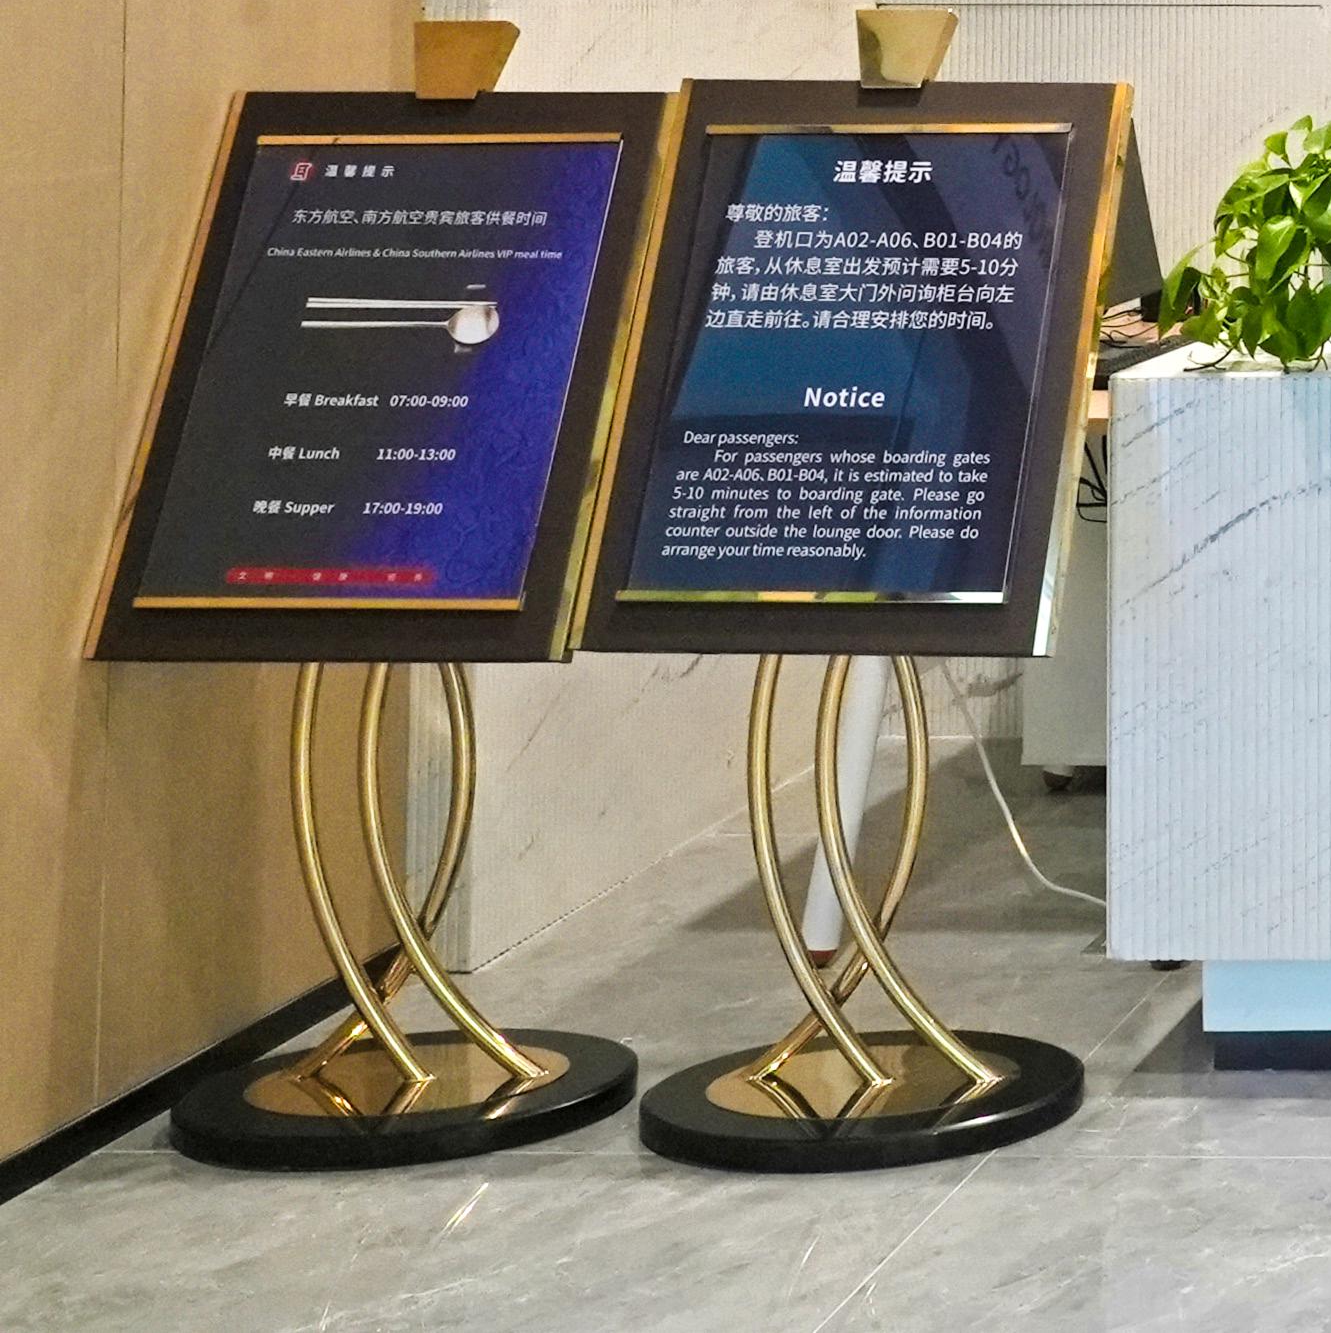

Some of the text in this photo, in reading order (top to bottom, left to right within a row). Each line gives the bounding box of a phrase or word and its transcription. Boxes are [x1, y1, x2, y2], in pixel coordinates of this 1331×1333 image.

[832, 159, 933, 184] 温馨提示
[267, 247, 563, 260] China Eastern Airlines & China Southern Airlines VIP meal time
[314, 393, 380, 407] Breakfast
[389, 394, 469, 408] 07:00-09:00
[803, 385, 885, 408] Notice
[683, 430, 799, 448] Dear passengers:
[298, 446, 340, 460] Lunch
[376, 448, 457, 461] 11:00-13:00
[714, 449, 991, 468] For passengers whose boarding gates
[675, 470, 700, 481] are
[833, 468, 844, 482] it
[848, 468, 860, 483] is
[863, 468, 934, 483] estimated
[938, 469, 954, 483] to
[958, 468, 988, 483] take
[672, 486, 985, 505] 5-10 minutes to boarding gate. Please go
[283, 501, 335, 517] Supper
[362, 501, 444, 515] 17:00-19:00
[668, 502, 982, 523] straight from the left of the information
[665, 523, 979, 543] counter outside the lounge door. Please do
[661, 542, 866, 561] arrange your time reasonably.
